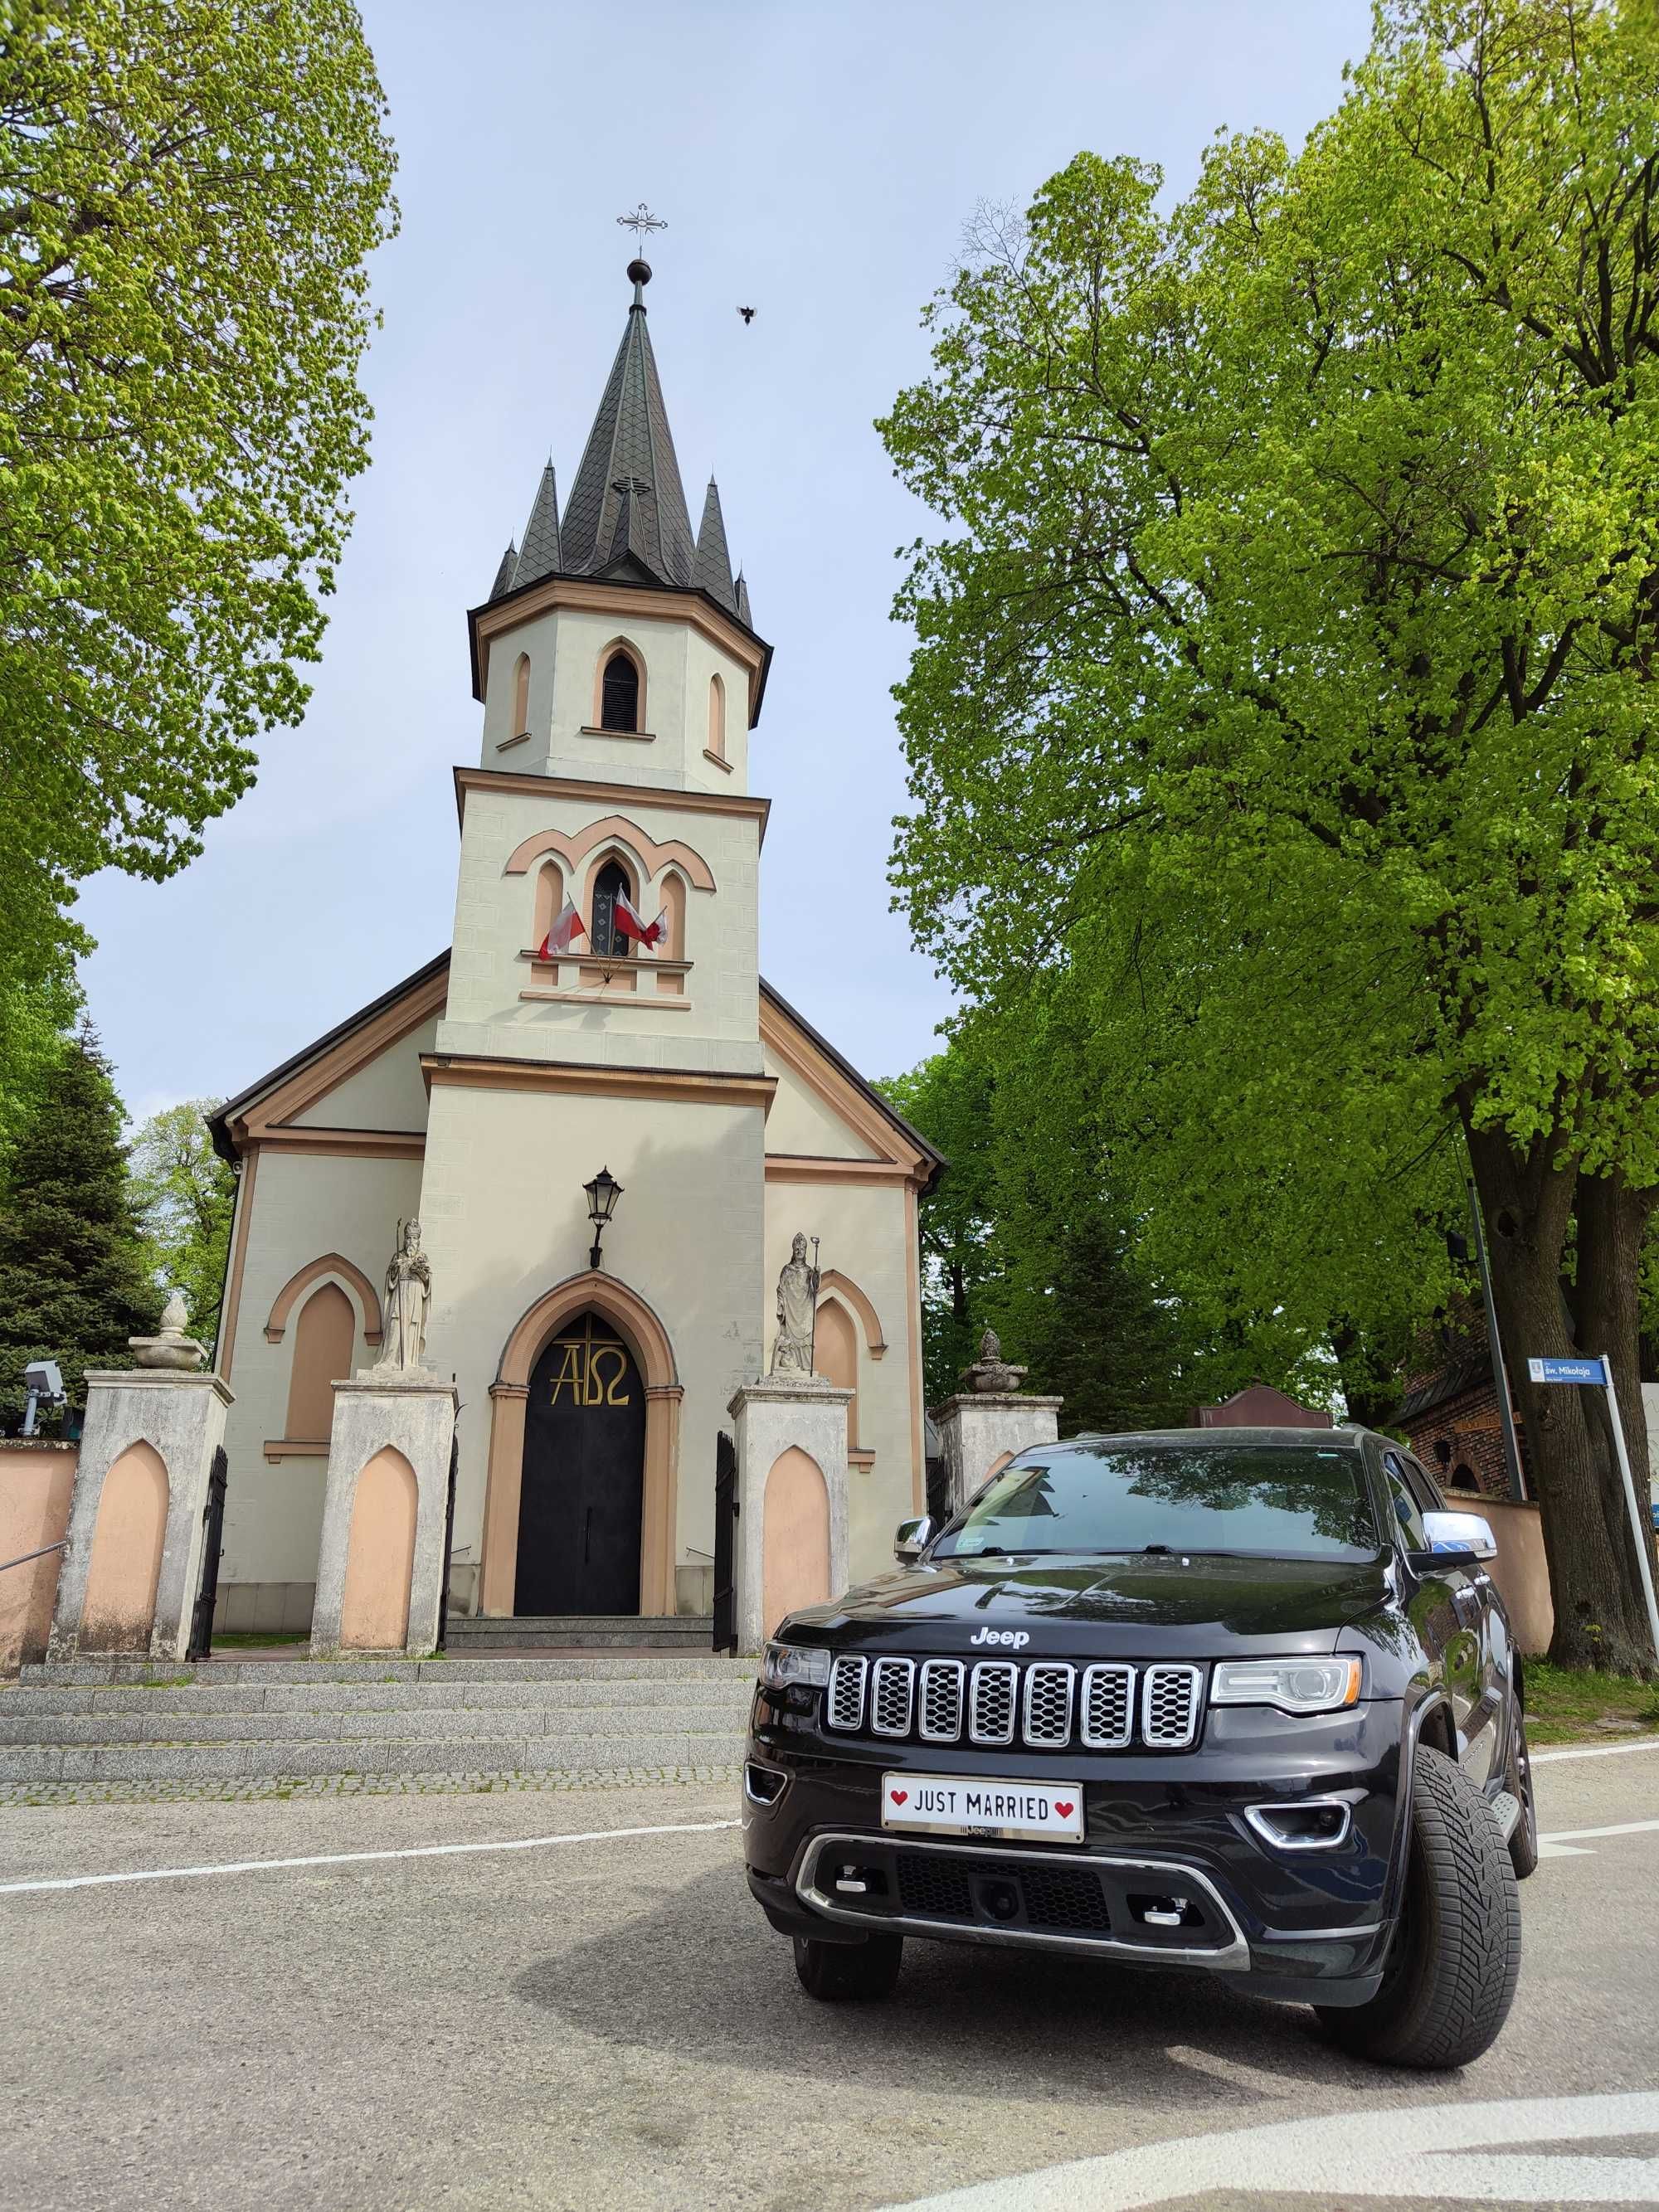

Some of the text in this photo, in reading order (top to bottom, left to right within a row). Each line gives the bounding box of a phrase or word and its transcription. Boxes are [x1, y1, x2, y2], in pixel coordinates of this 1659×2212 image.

[1545, 1365, 1591, 1378] św. Mikołaja
[971, 1626, 1029, 1650] Jeep
[914, 1789, 1049, 1821] JUST MARRIED
[967, 1826, 991, 1838] Jeep
